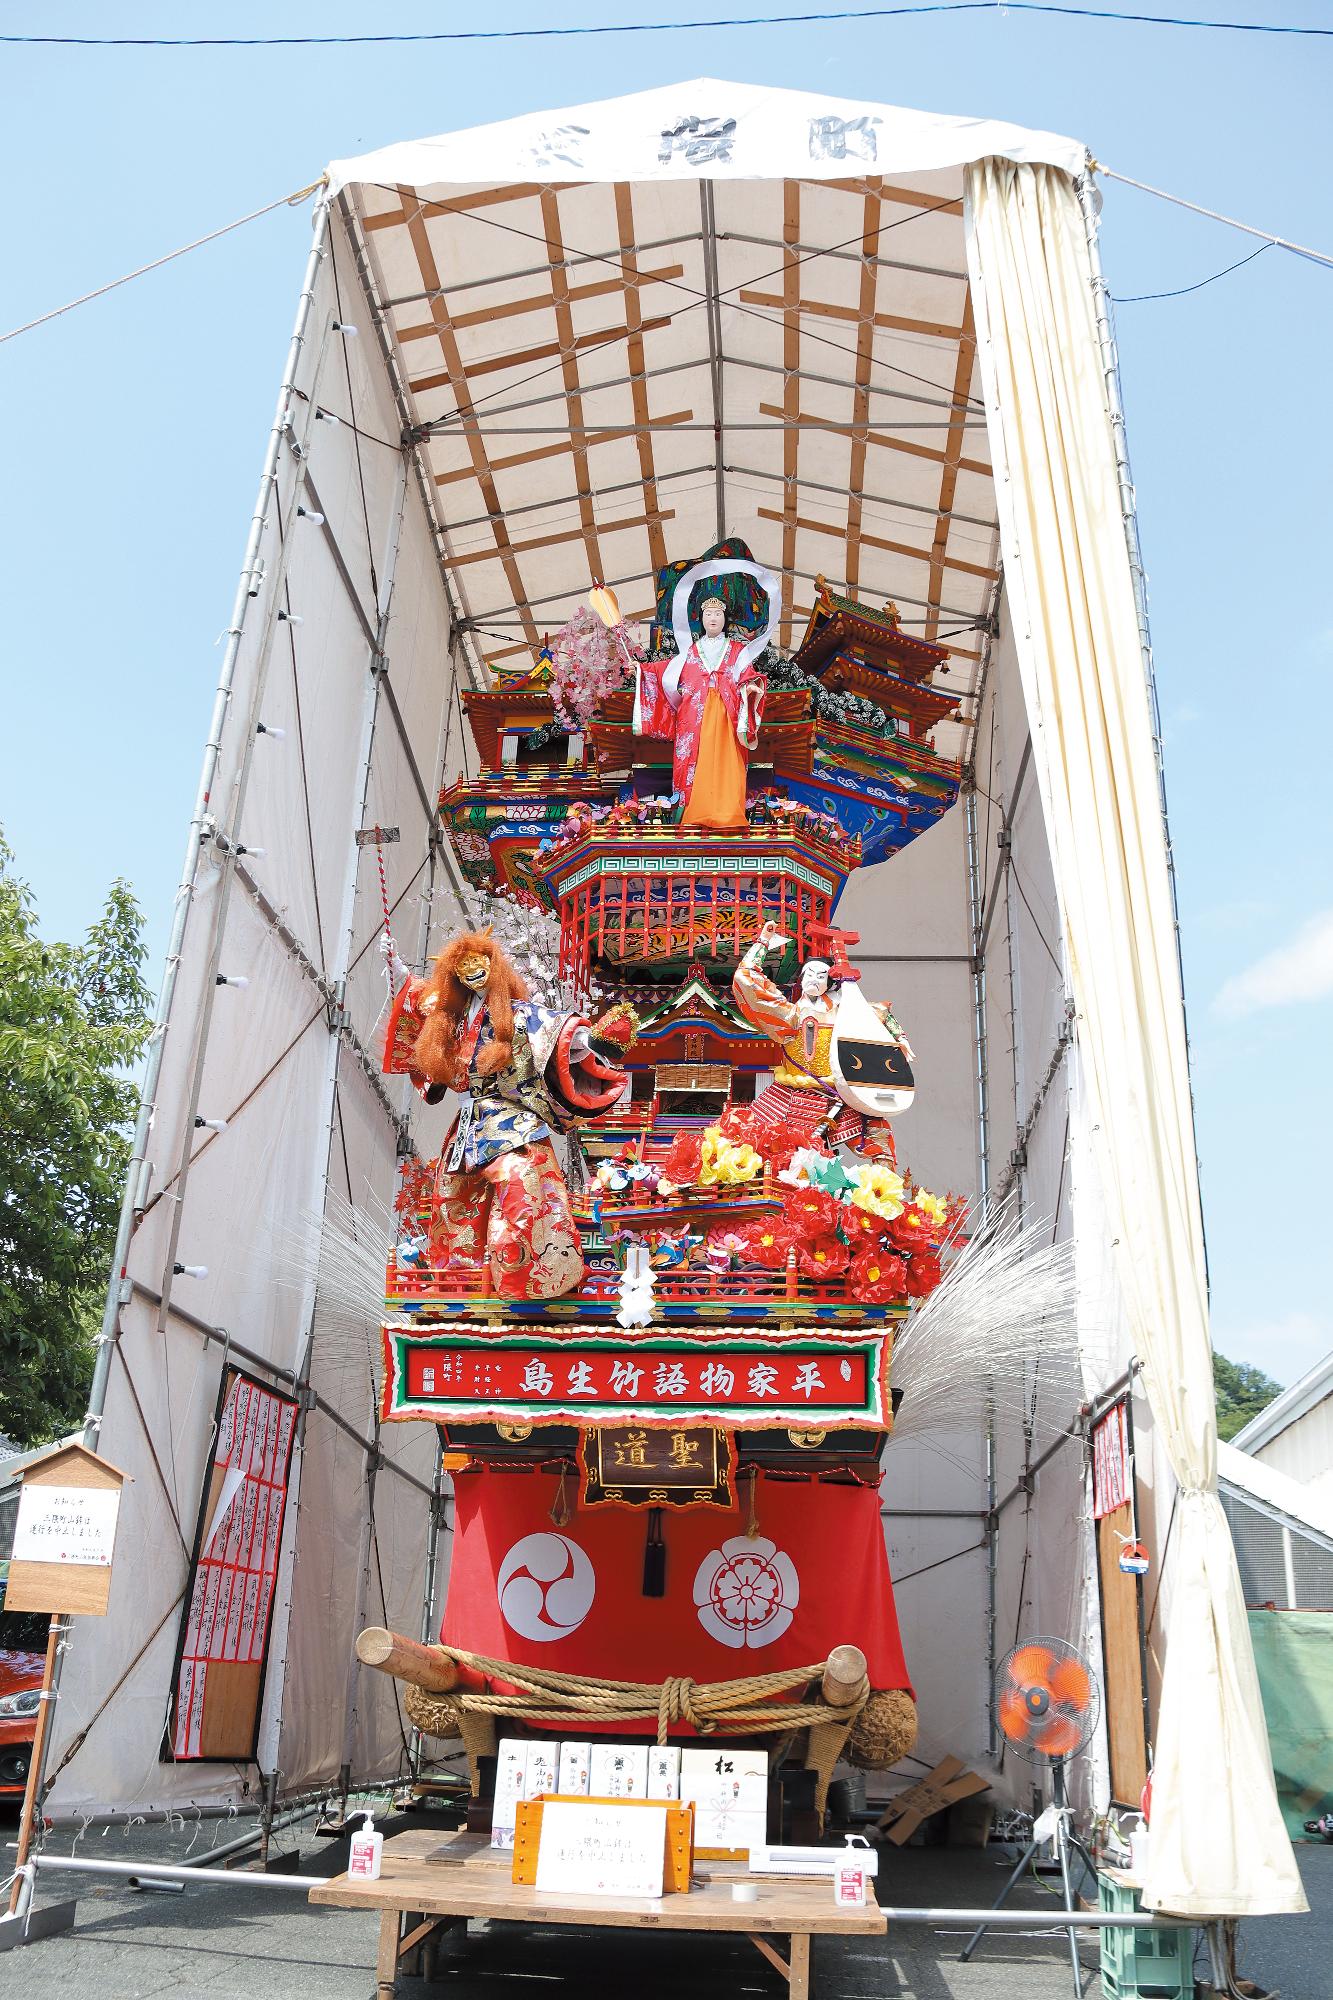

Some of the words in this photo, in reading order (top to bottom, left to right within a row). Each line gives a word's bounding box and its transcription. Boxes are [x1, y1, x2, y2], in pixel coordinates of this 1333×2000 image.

[443, 1354, 452, 1382] 三隈町
[715, 1755, 734, 1776] 松
